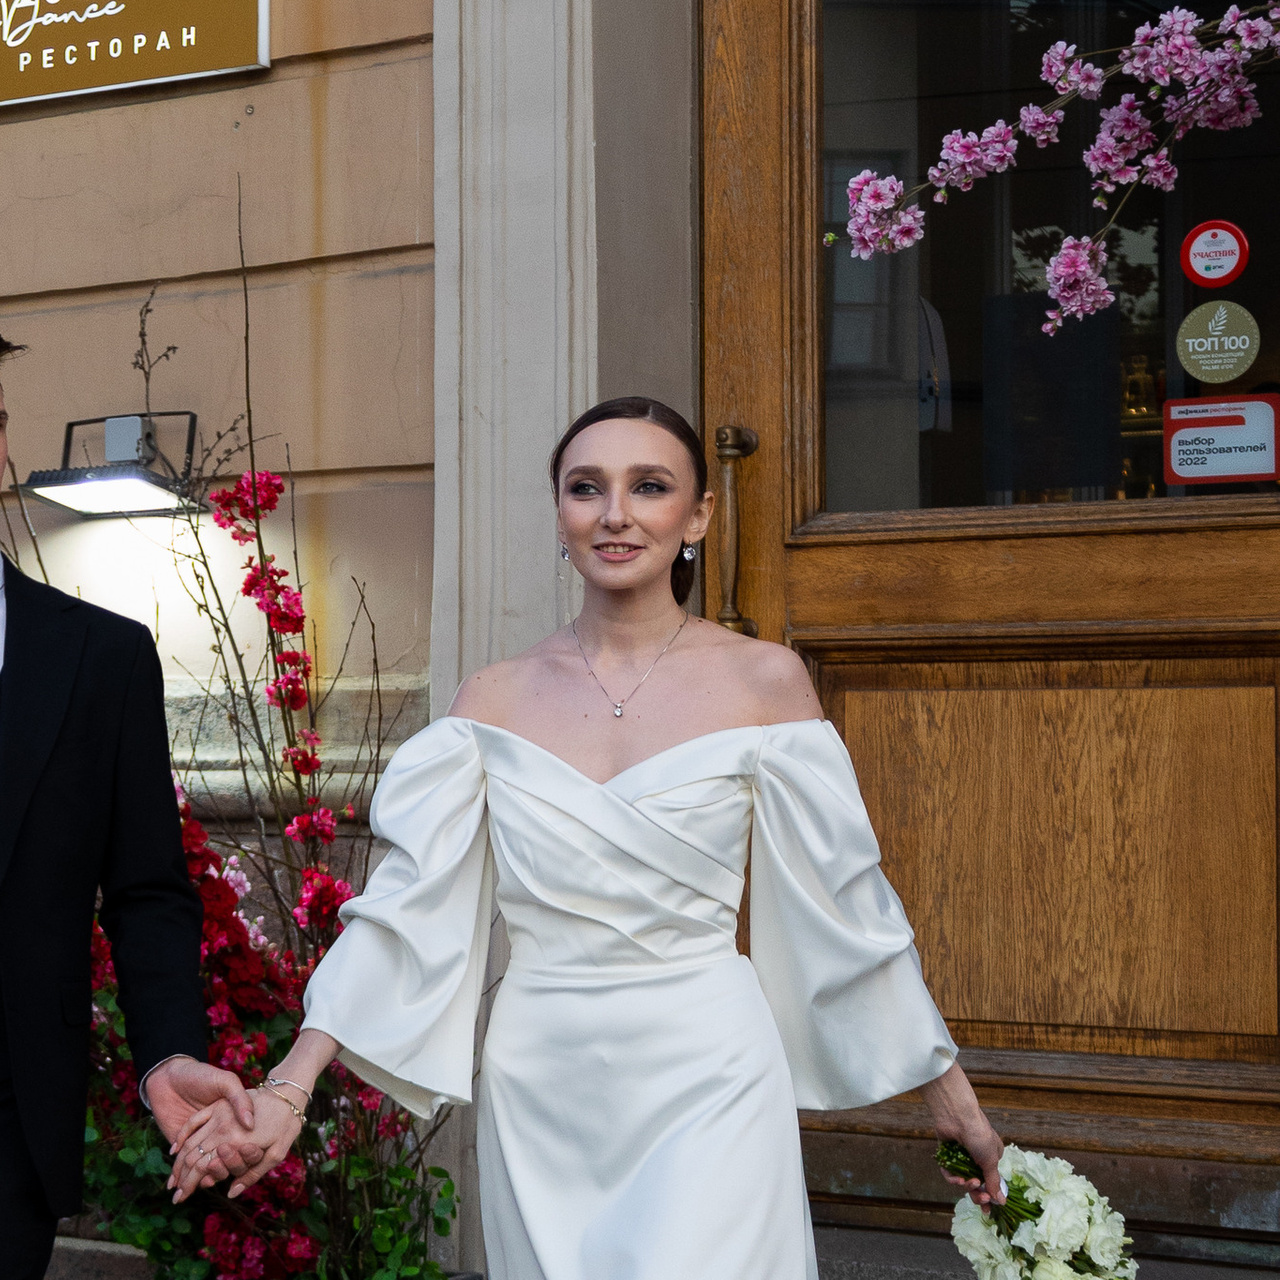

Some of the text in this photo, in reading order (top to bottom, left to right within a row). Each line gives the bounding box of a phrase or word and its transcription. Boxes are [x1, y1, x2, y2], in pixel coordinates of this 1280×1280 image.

[19, 26, 197, 72] РЕСТОРАН
[1193, 249, 1236, 259] УЧАСТНИК
[1185, 335, 1250, 352] ТОП 100
[1178, 437, 1215, 446] выбор
[1178, 443, 1267, 455] пользователей
[1178, 457, 1207, 466] 2022
